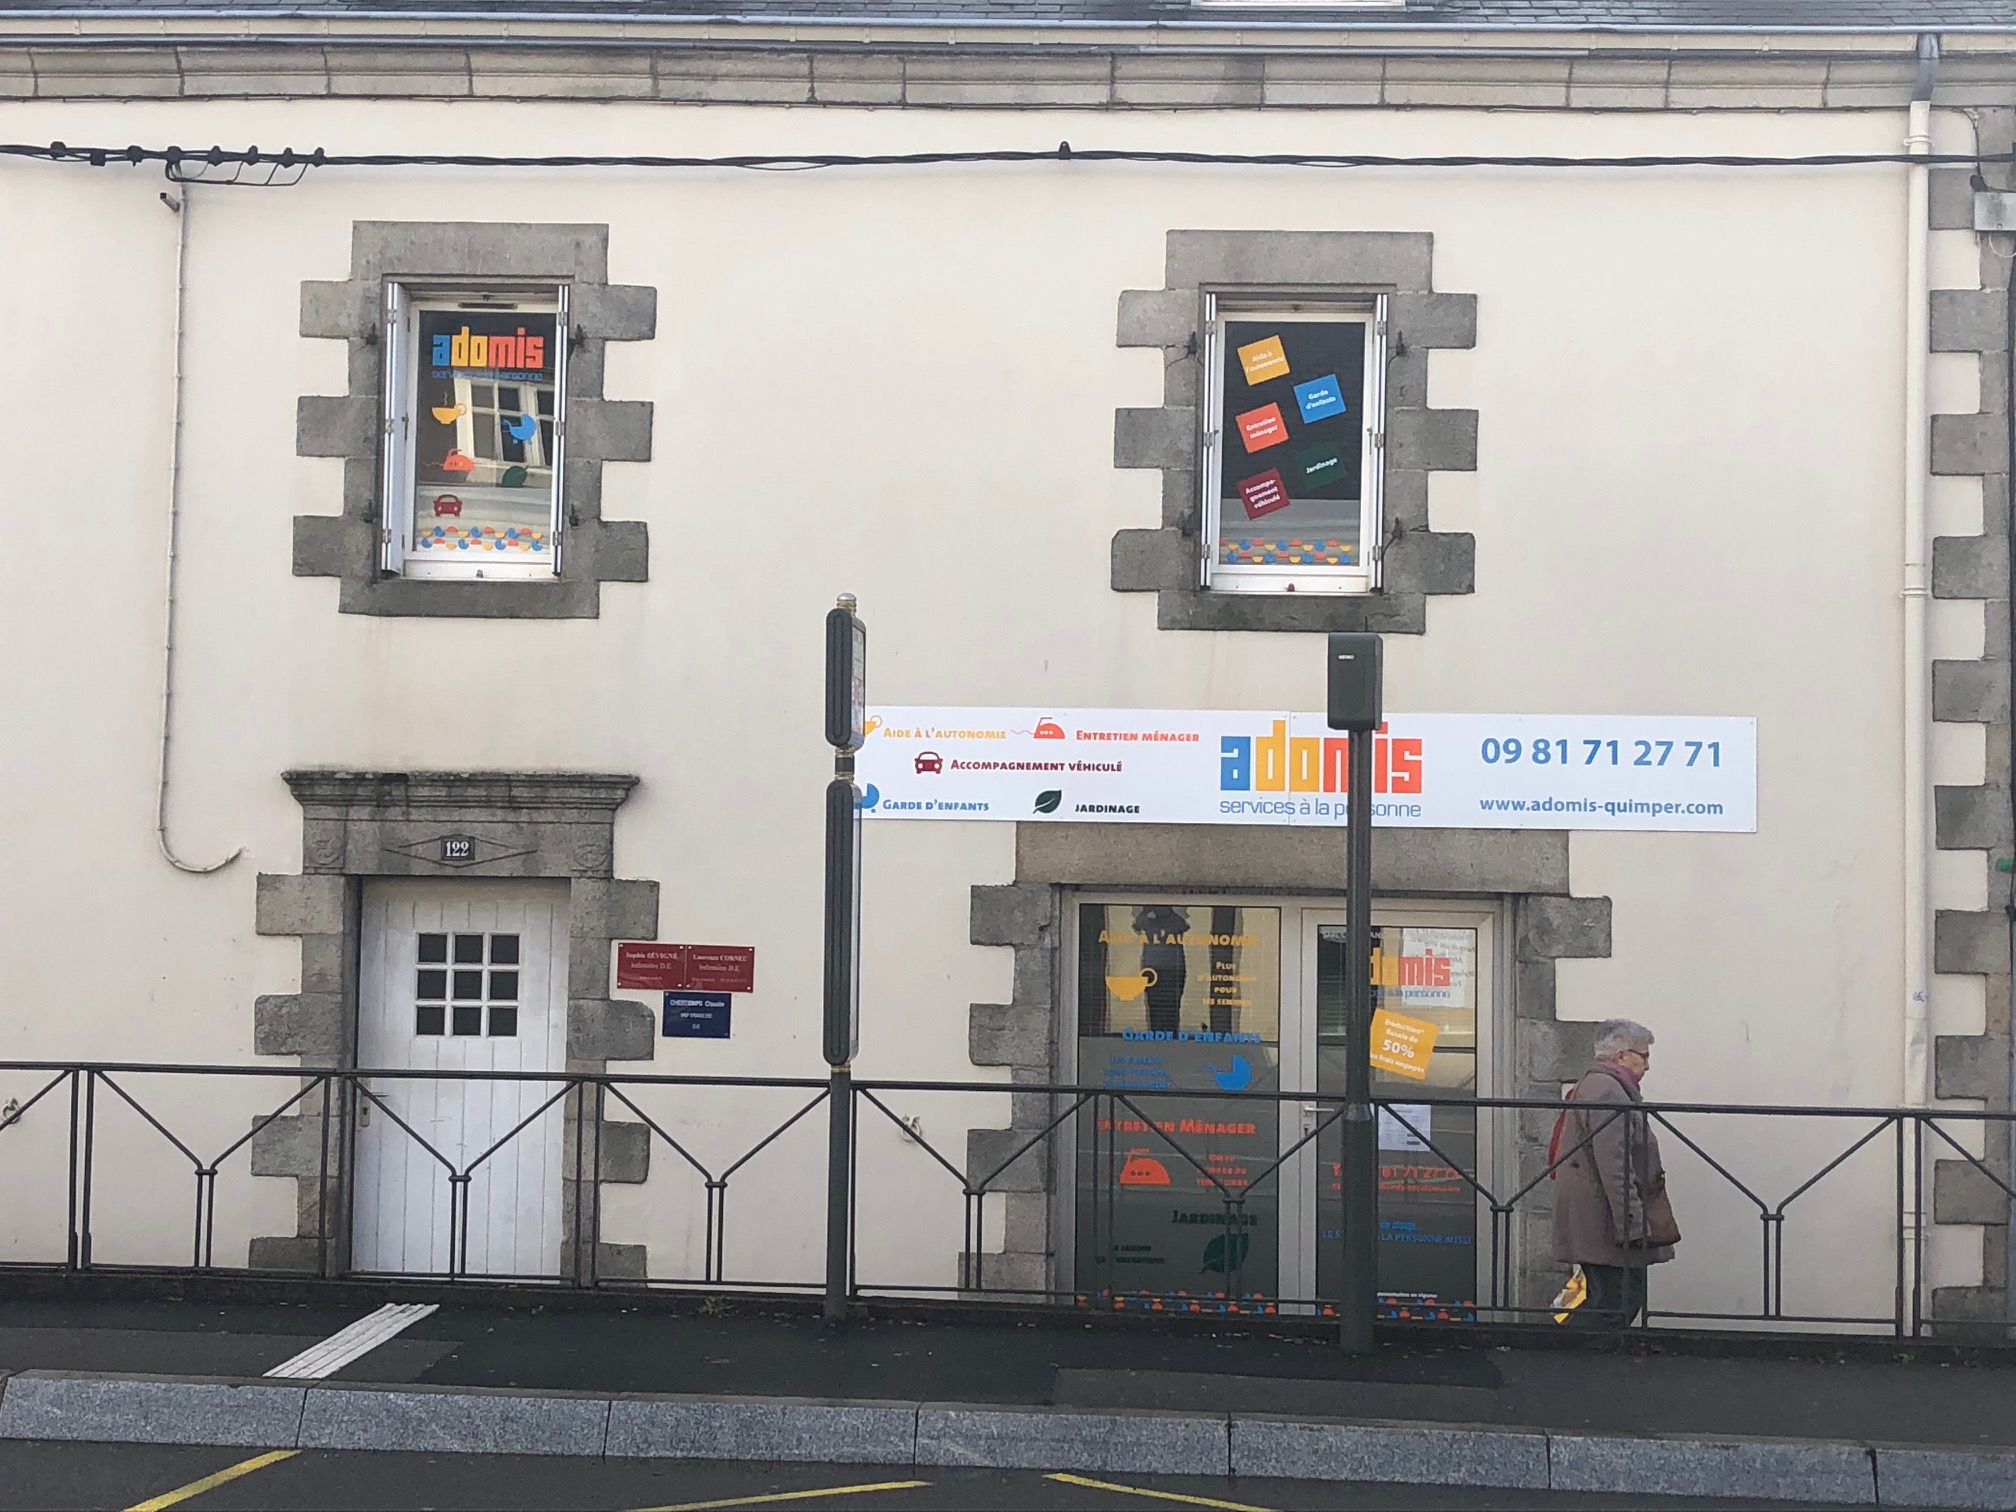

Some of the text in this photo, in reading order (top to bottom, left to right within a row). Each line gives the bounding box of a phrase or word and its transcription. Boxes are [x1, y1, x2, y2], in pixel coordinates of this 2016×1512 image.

[432, 326, 544, 369] adomis
[1308, 389, 1329, 400] Garde
[1306, 396, 1336, 410] d'enfants
[1246, 416, 1277, 431] Entretien
[1250, 424, 1279, 439] ménager
[1306, 457, 1338, 474] Jardinage
[883, 725, 1007, 740] AIDE À L'AUTONOMIE
[1076, 730, 1200, 743] ENTRETIEN MÉNAGER
[1481, 737, 1721, 767] 09 81 71 27 71
[950, 759, 1123, 772] ACCOMPAGNEMENT VÉHICULÉ
[883, 799, 990, 812] GARDE D'ENFANTS
[1075, 803, 1141, 814] JARDINAGE
[1219, 796, 1296, 815] services
[1299, 798, 1311, 816] à
[1315, 798, 1330, 816] la
[1479, 796, 1724, 817] www.adomis-quimper.com
[446, 841, 469, 857] 122
[1122, 1027, 1262, 1045] GARDE D'ENFANTS
[1382, 1039, 1415, 1059] 50%
[1179, 1118, 1257, 1135] MÉNAGER
